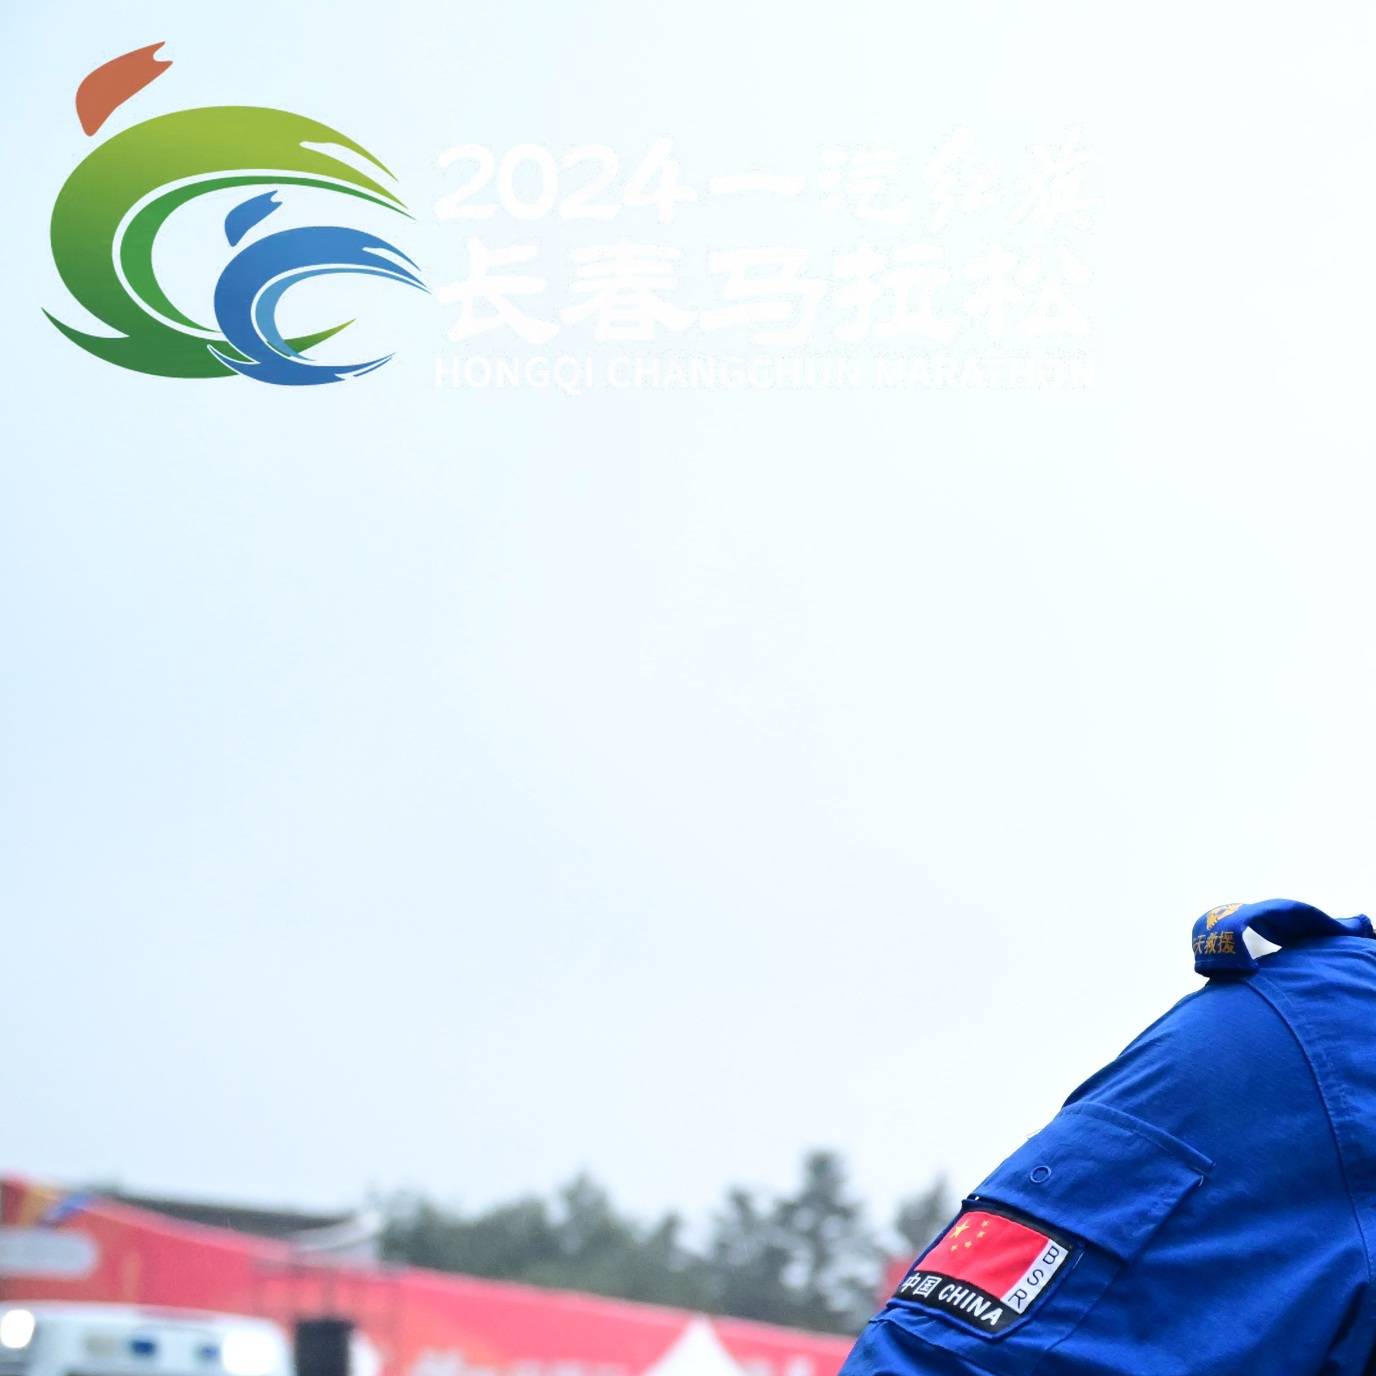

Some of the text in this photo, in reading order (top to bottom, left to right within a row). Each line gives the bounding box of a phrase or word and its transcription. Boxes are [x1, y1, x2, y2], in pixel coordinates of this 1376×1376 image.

[900, 1272, 1003, 1326] 中国 CHINA
[1008, 1246, 1060, 1309] BSR
